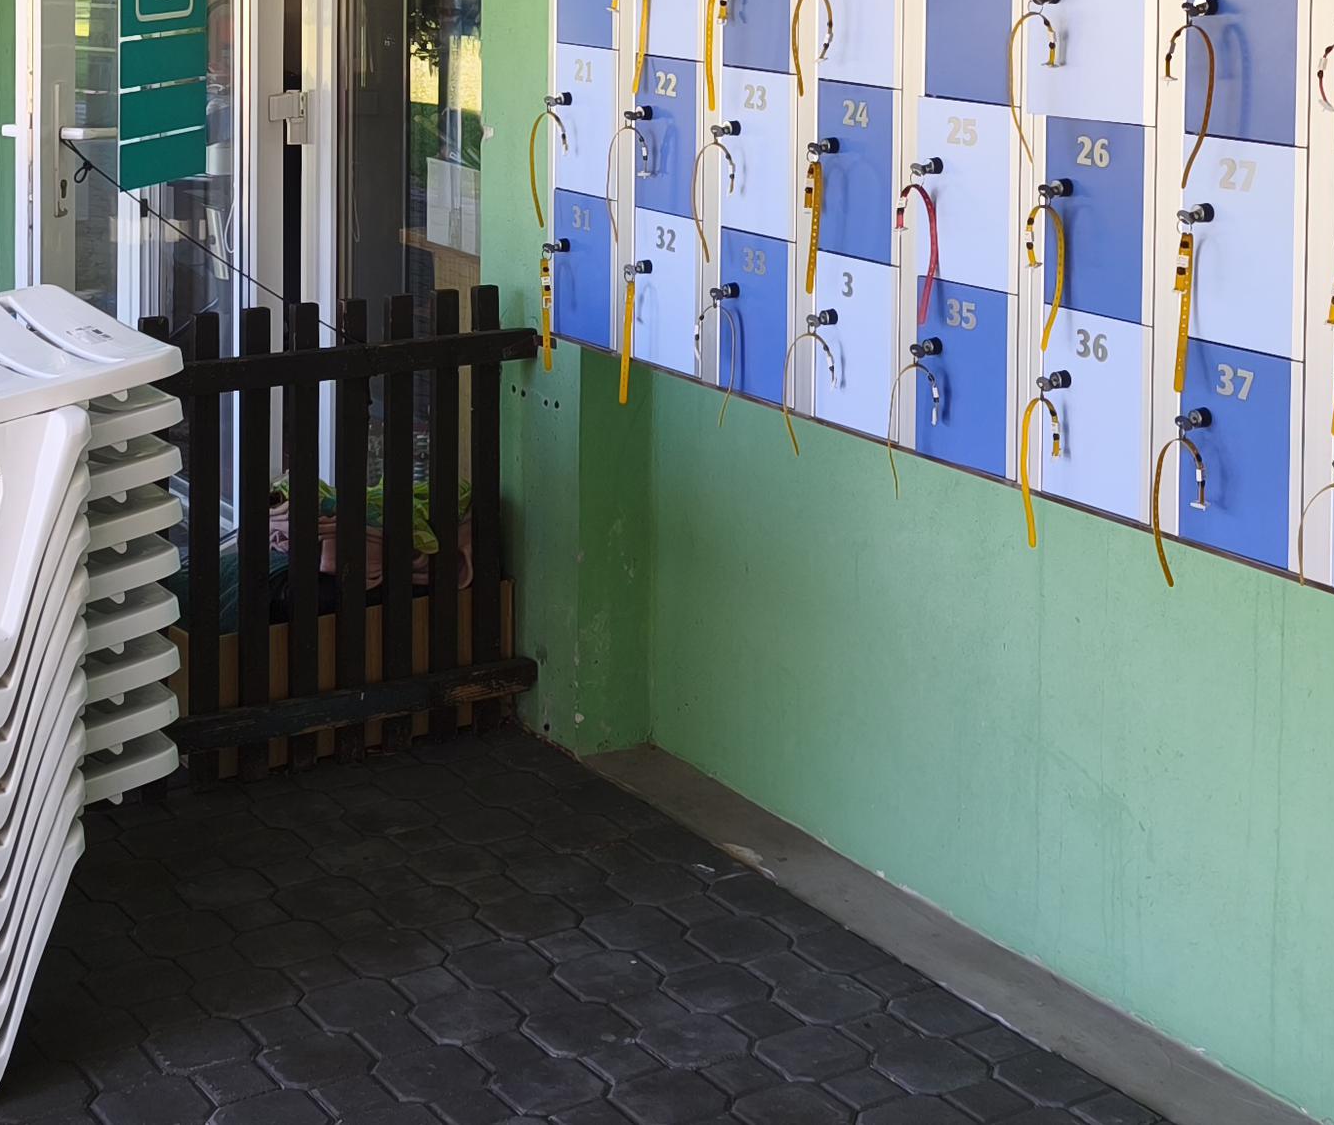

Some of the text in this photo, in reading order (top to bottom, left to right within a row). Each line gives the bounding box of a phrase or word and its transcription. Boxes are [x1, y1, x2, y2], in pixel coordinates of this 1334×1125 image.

[574, 59, 593, 83] 21
[655, 71, 677, 98] 22
[744, 84, 767, 111] 23
[842, 100, 869, 128] 24
[946, 116, 978, 147] 25
[1076, 135, 1110, 168] 26
[1218, 157, 1257, 192] 27
[572, 205, 591, 232] 31
[656, 227, 676, 253] 32
[742, 247, 766, 275] 33
[841, 272, 853, 298] 3
[946, 298, 977, 331] 35
[1075, 328, 1108, 363] 36
[1216, 363, 1254, 401] 37
